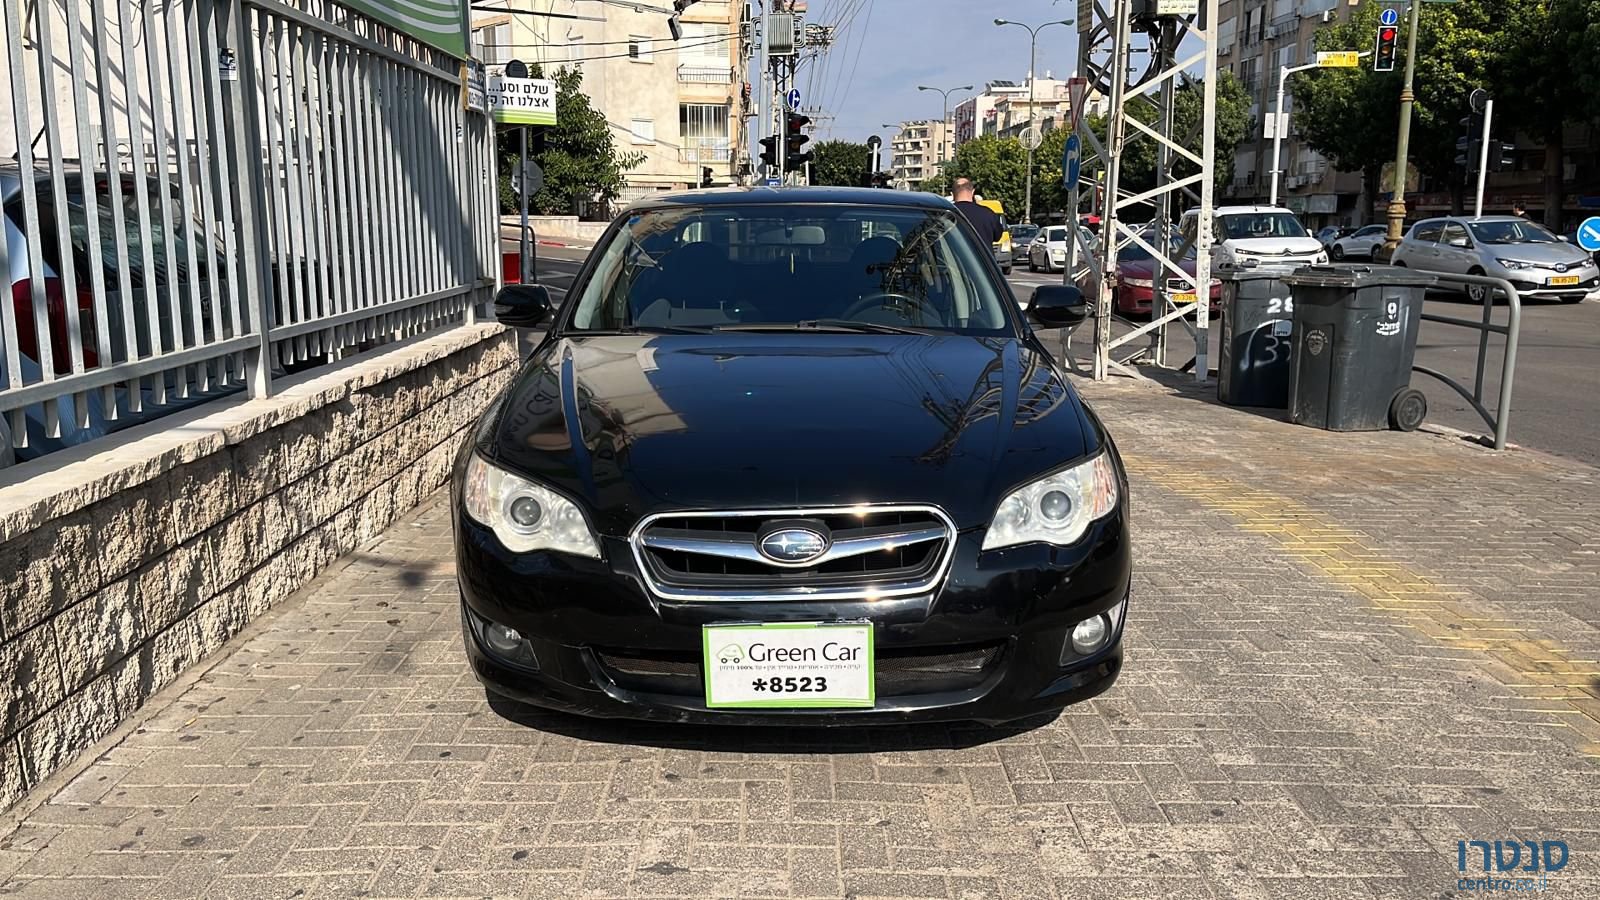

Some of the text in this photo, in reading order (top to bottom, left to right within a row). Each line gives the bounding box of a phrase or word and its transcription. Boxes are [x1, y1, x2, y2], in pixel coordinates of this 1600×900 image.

[488, 82, 549, 94] שלם וסע...
[502, 95, 514, 105] זה
[517, 94, 549, 107] אצלנו
[748, 642, 861, 662] Green Car
